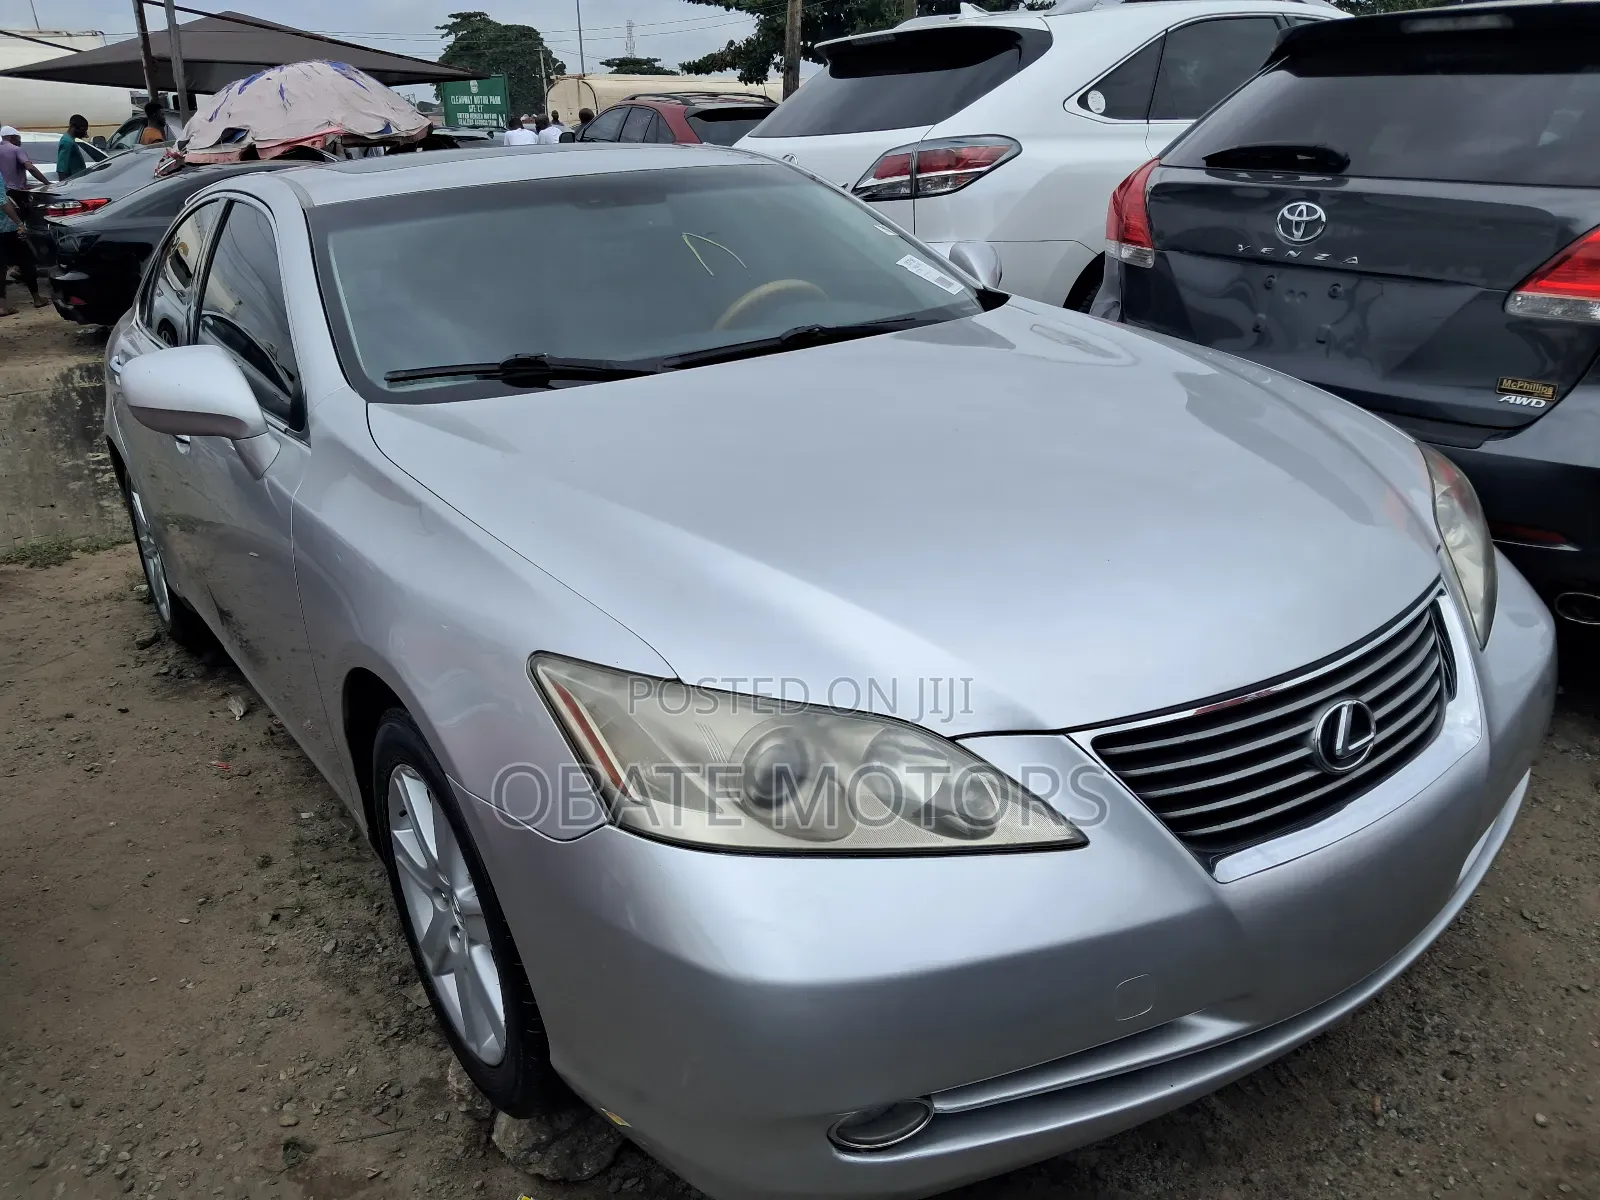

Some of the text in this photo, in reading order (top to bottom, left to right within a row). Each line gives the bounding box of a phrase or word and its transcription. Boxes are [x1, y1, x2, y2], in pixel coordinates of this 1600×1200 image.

[1237, 243, 1361, 265] VENZA
[1501, 378, 1555, 394] McPhillips
[1498, 395, 1547, 408] AWD
